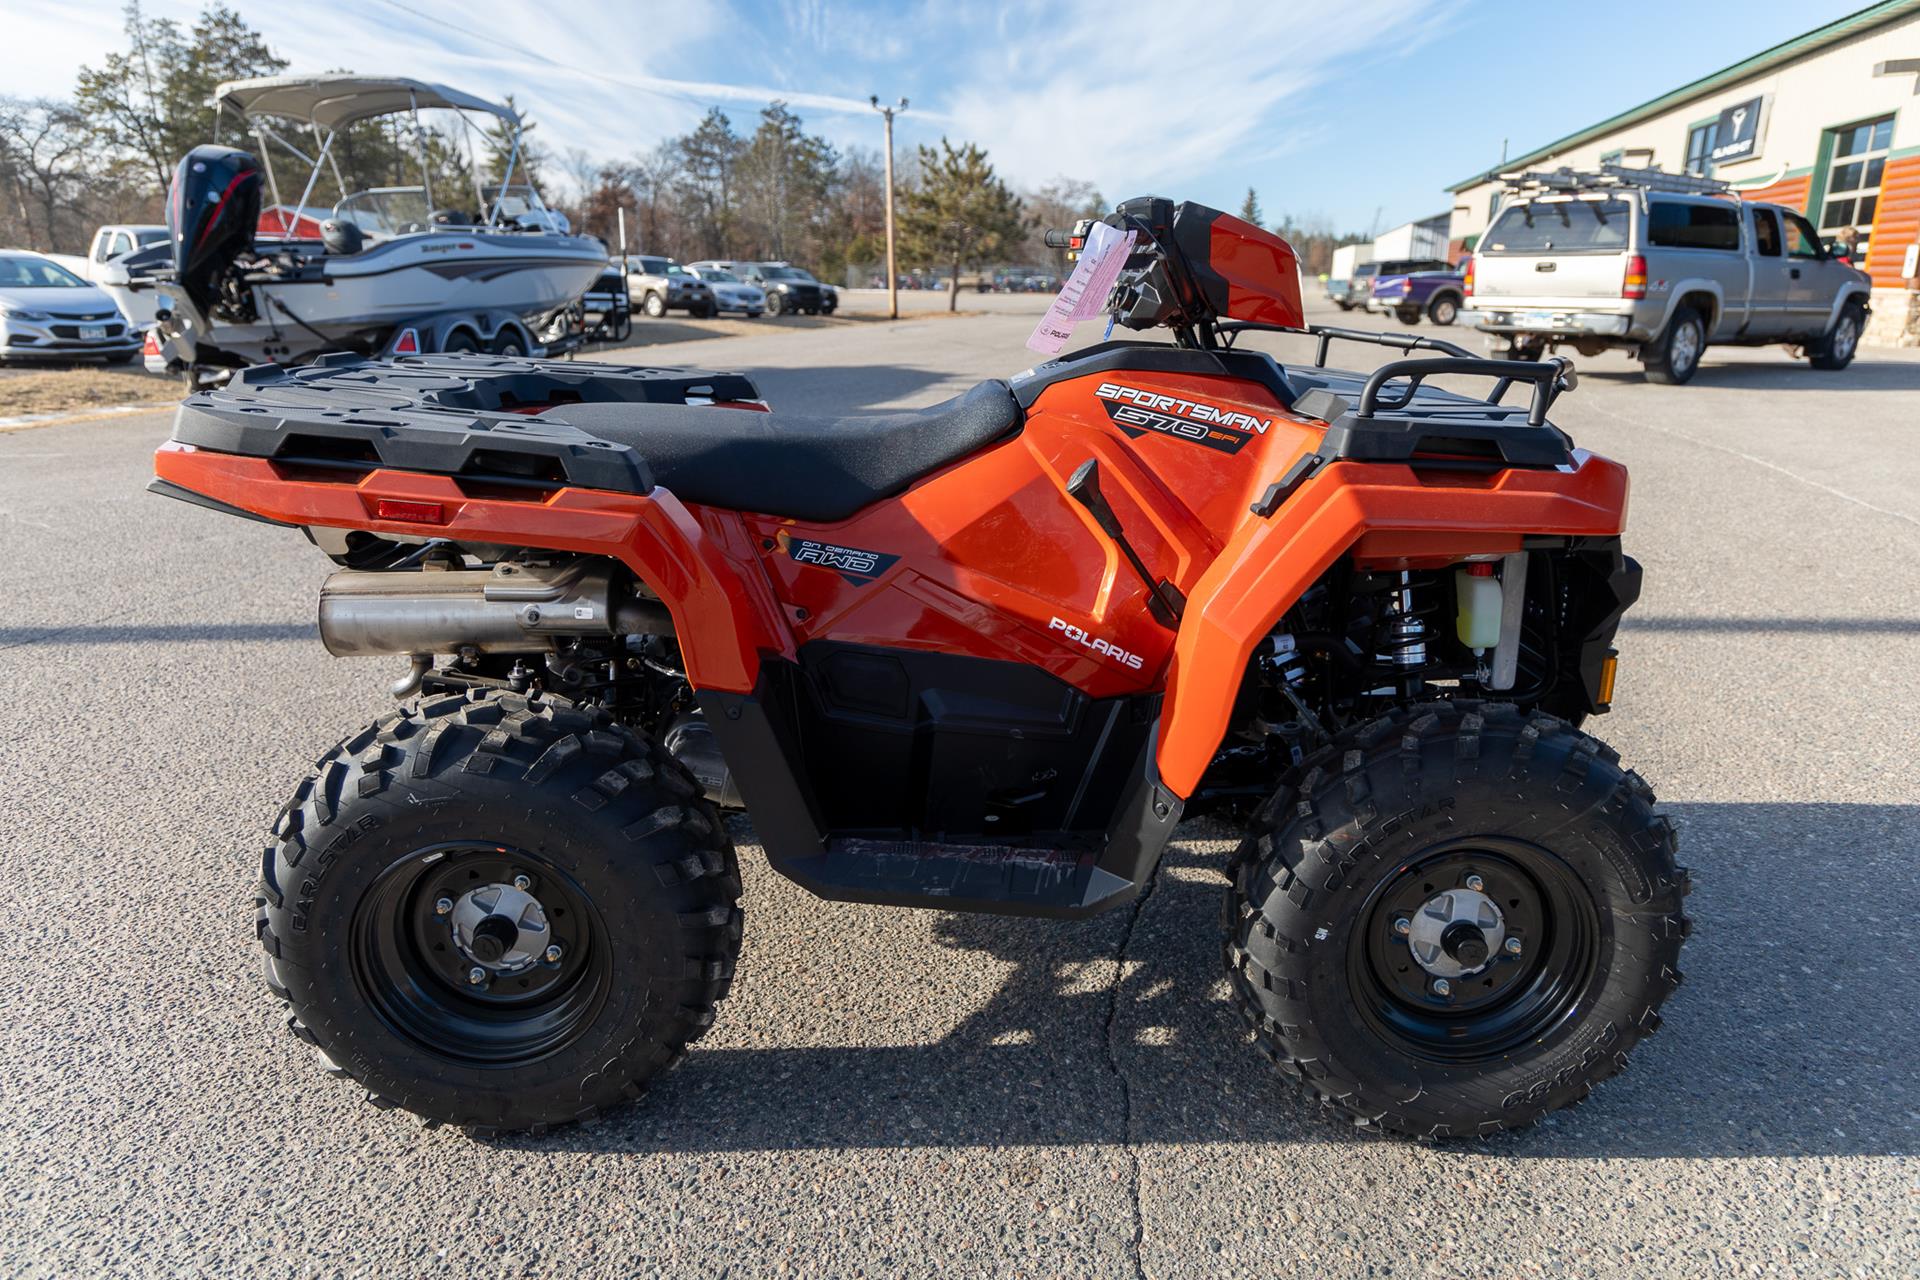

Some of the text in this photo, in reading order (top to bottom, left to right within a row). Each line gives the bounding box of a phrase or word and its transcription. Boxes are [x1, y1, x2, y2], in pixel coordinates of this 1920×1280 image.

[1094, 382, 1272, 435] SPORTSMAN
[1113, 406, 1240, 445] 570 EFI
[795, 547, 875, 573] AWD
[802, 541, 879, 560] ON DEMAND
[1048, 616, 1144, 670] POLARIS
[292, 813, 380, 933] CARLSTAR
